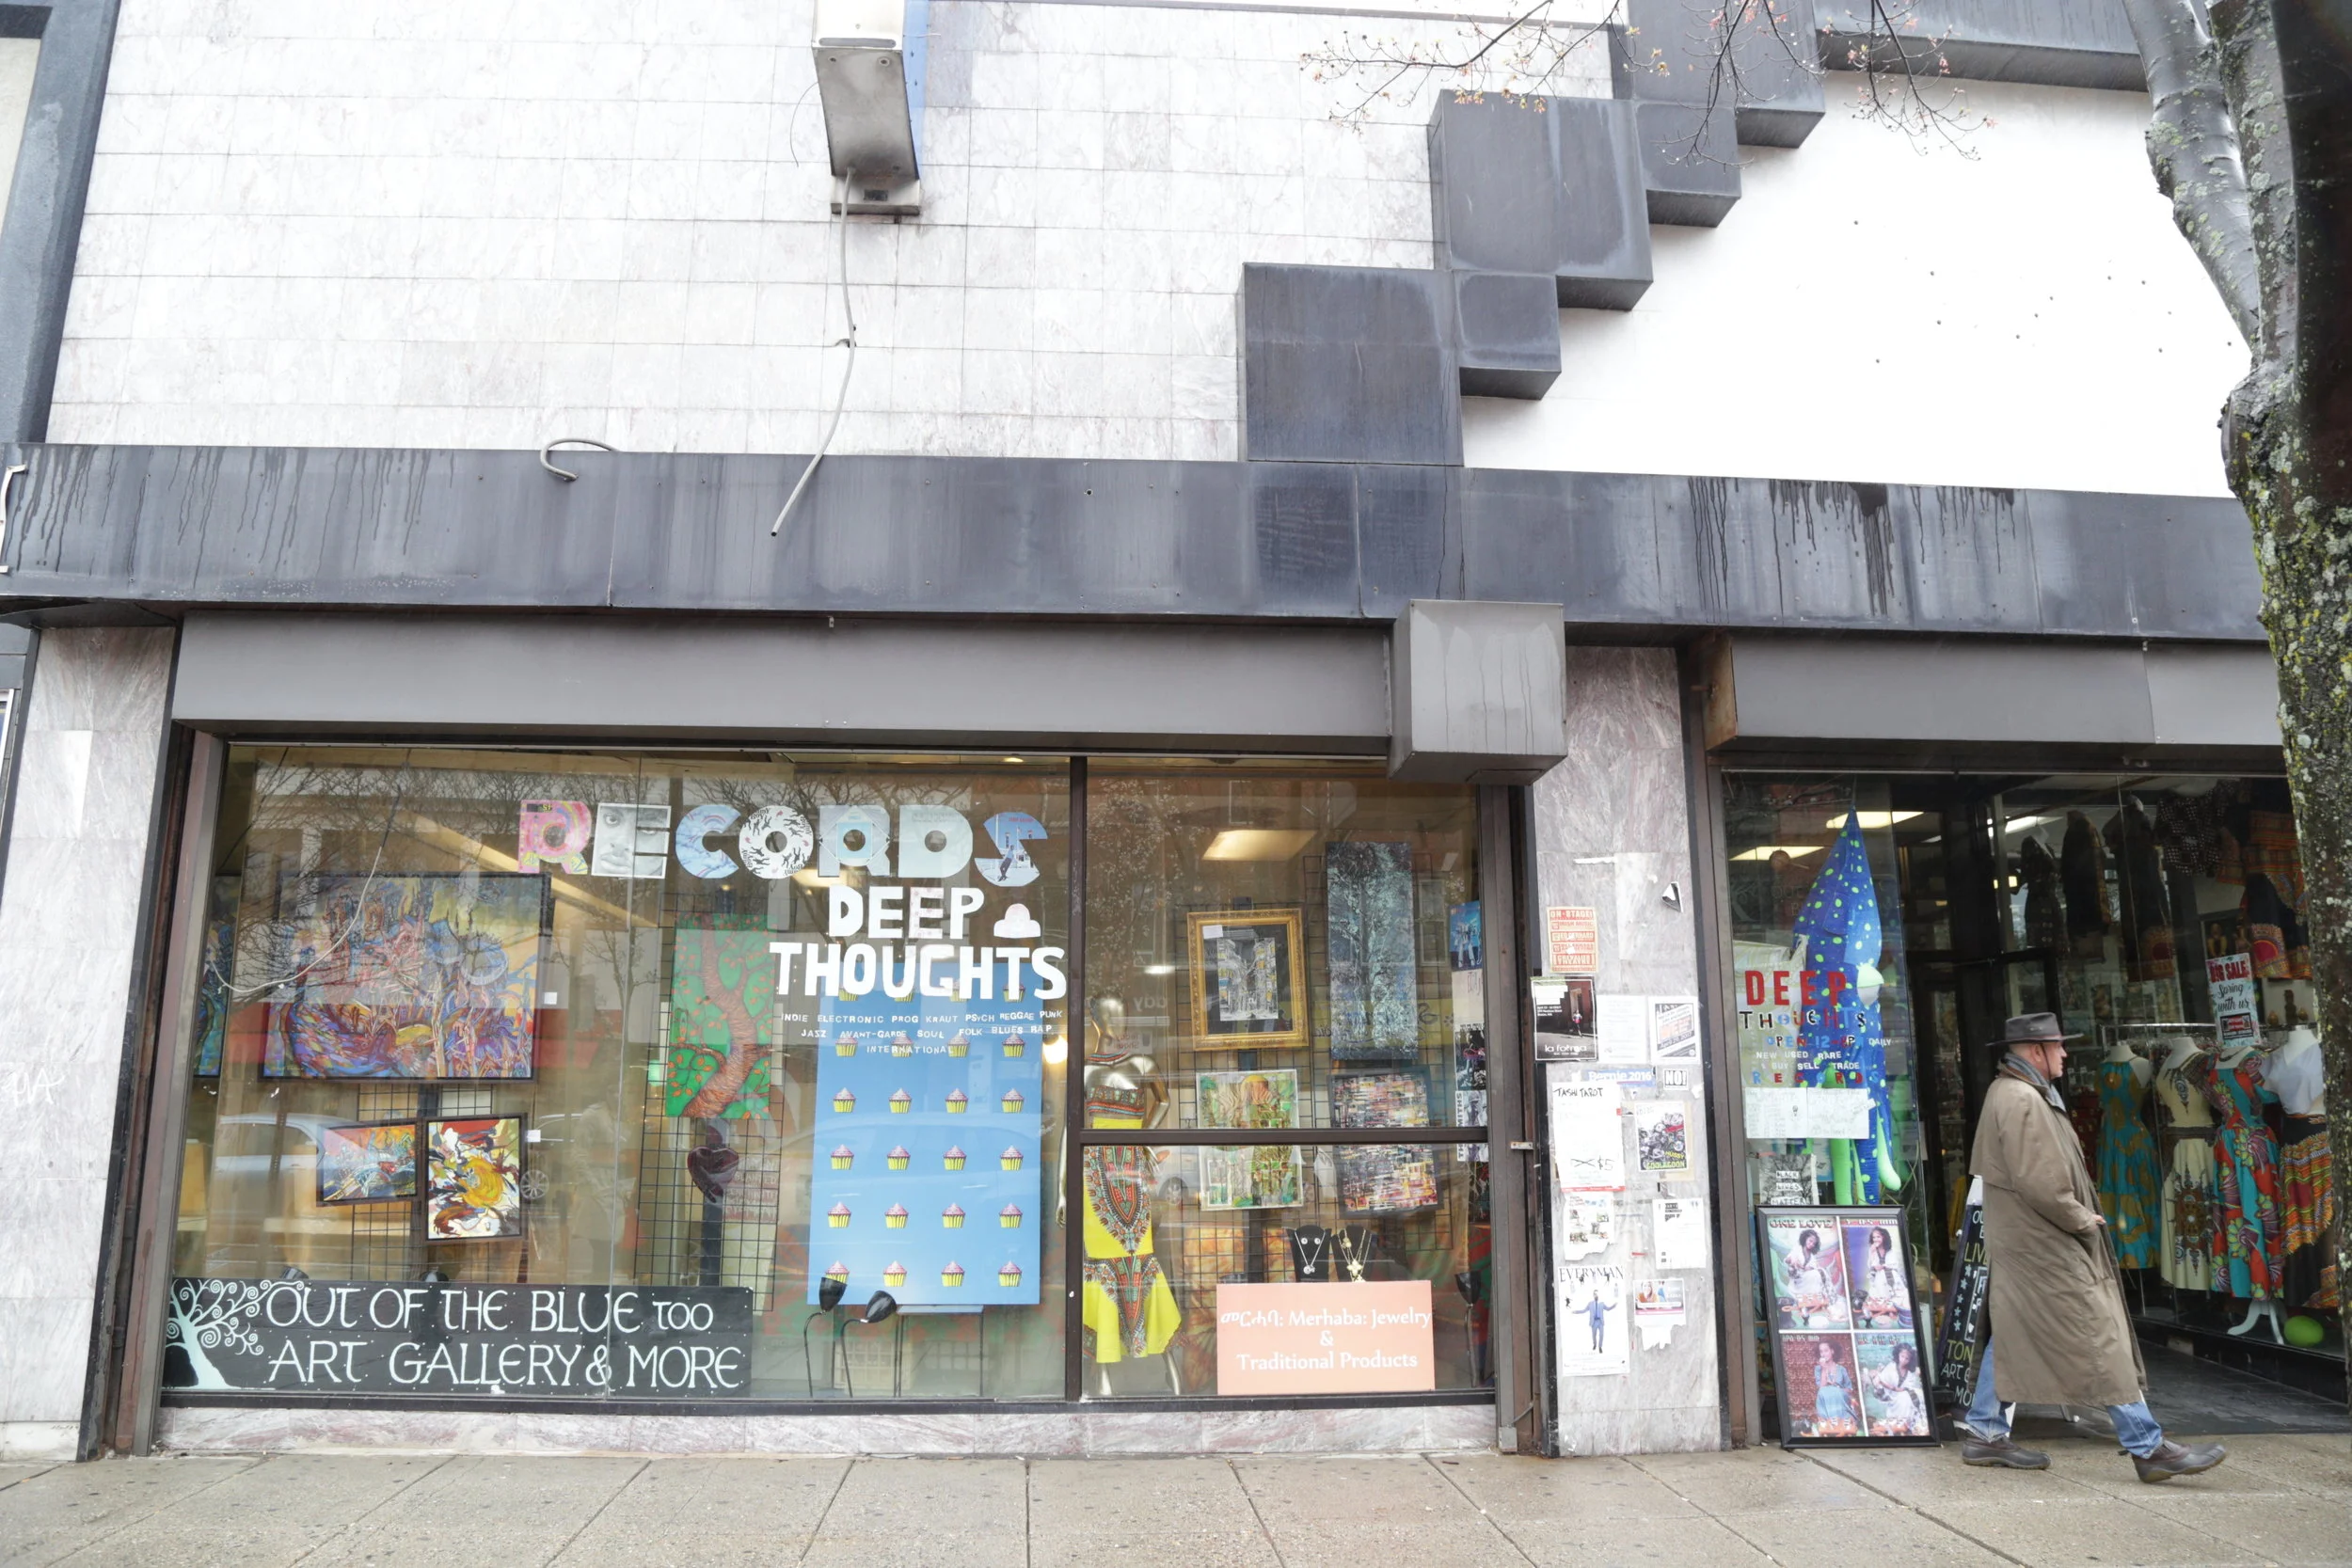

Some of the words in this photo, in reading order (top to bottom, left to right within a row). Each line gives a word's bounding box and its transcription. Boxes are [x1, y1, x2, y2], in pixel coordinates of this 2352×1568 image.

[517, 800, 1048, 887] RECORDS
[829, 886, 985, 940] DEEP
[769, 942, 1067, 1000] THOUGHTS
[2225, 960, 2249, 980] SALE
[1744, 970, 1847, 1006] DEEP
[2217, 984, 2243, 998] Spring
[2218, 998, 2235, 1012] with
[2239, 999, 2249, 1008] us
[782, 1014, 809, 1022] INDIE
[818, 1014, 884, 1023] ELECTRONIC
[892, 1015, 919, 1023] PROG
[926, 1015, 958, 1023] KRAUT
[999, 1011, 1035, 1021] REGGAE
[1040, 1010, 1062, 1019] PUNK
[1739, 1008, 1867, 1030] THOUGHTS
[801, 1029, 827, 1038] JAZZ
[840, 1030, 907, 1038] AVANT-GARDE
[917, 1030, 945, 1039] SOUL
[959, 1027, 983, 1036] FOLK
[992, 1025, 1024, 1035] BLUES
[1031, 1025, 1053, 1034] RAP
[866, 1045, 953, 1054] INTERNATIONAL
[1767, 1036, 1807, 1048] OPEN
[1868, 1037, 1892, 1047] DAILY
[1784, 1051, 1808, 1059] USED
[1818, 1051, 1841, 1059] RARE
[1797, 1062, 1820, 1070] SELL
[1588, 1070, 1627, 1081] Bernie
[1628, 1071, 1651, 1081] 2016
[1665, 1070, 1687, 1085] NO!
[1580, 1087, 1603, 1098] TAROT
[1597, 1155, 1615, 1171] $5
[1770, 1219, 1795, 1228] ONE
[1799, 1219, 1833, 1228] LOVE
[1559, 1266, 1624, 1283] EVERYMAN
[266, 1286, 362, 1328] OUT
[370, 1288, 428, 1329] OF
[441, 1290, 508, 1331] THE
[530, 1287, 641, 1334] BLUE
[653, 1301, 713, 1332] TOO
[1288, 1308, 1367, 1326] Merhaba:
[1371, 1307, 1432, 1329] Jewelry
[1320, 1330, 1334, 1346] &
[1947, 1339, 1975, 1361] TON
[268, 1339, 369, 1383] ART
[389, 1341, 582, 1386] GALLERY
[585, 1345, 612, 1386] &
[627, 1345, 742, 1388] MORE
[1236, 1352, 1333, 1370] Traditional
[1340, 1349, 1418, 1370] Products
[1940, 1363, 1963, 1379] ART
